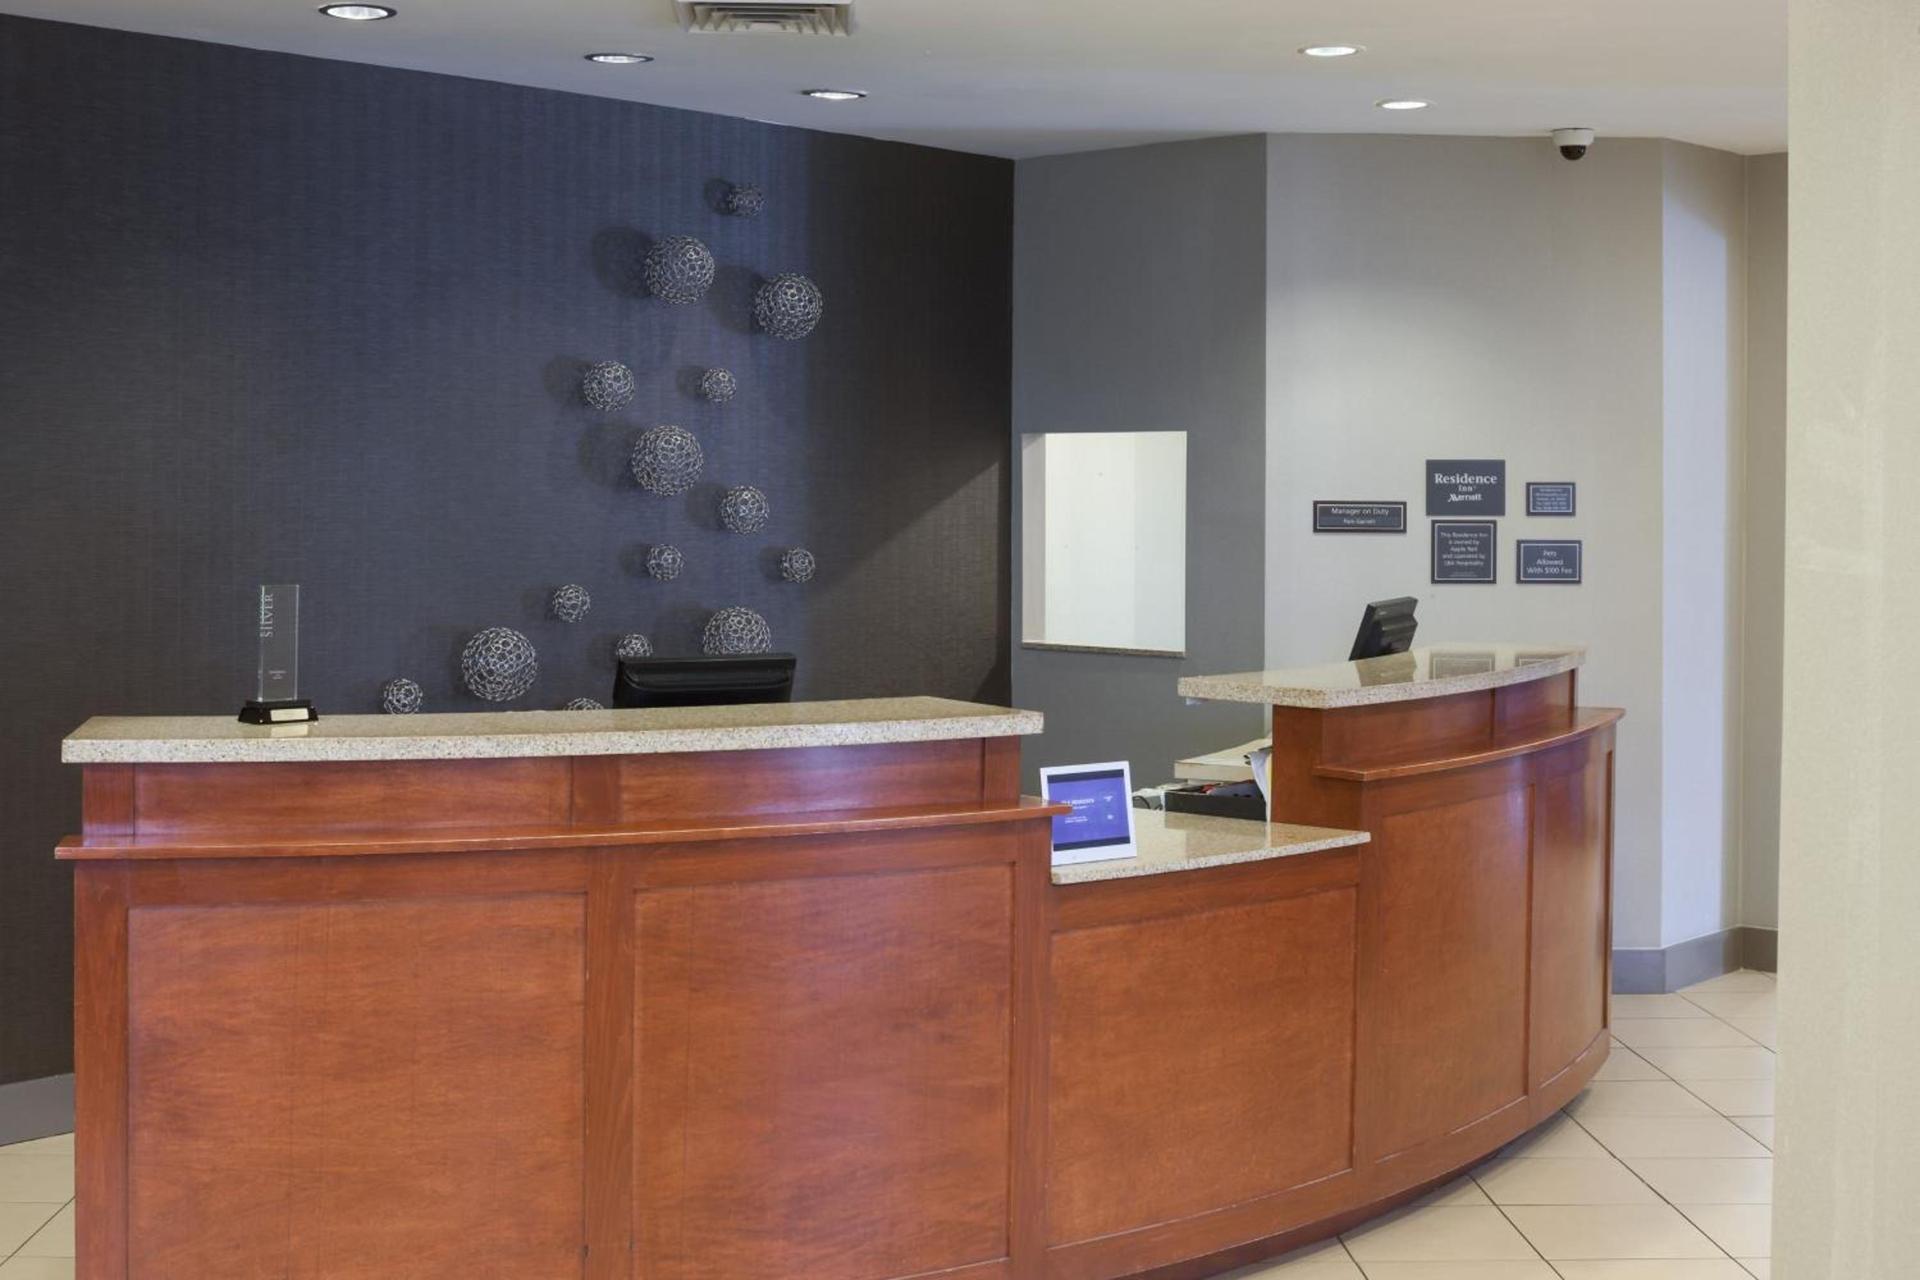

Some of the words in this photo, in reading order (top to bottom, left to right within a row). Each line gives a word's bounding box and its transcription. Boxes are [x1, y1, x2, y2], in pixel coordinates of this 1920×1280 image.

[1434, 473, 1498, 484] Residence
[1447, 493, 1483, 503] Marriott
[1331, 507, 1361, 516] Manager
[1372, 508, 1389, 516] Duty
[1526, 566, 1543, 574] With
[1544, 566, 1560, 574] $100
[1560, 566, 1573, 574] Fee
[263, 593, 274, 638] SILVER
